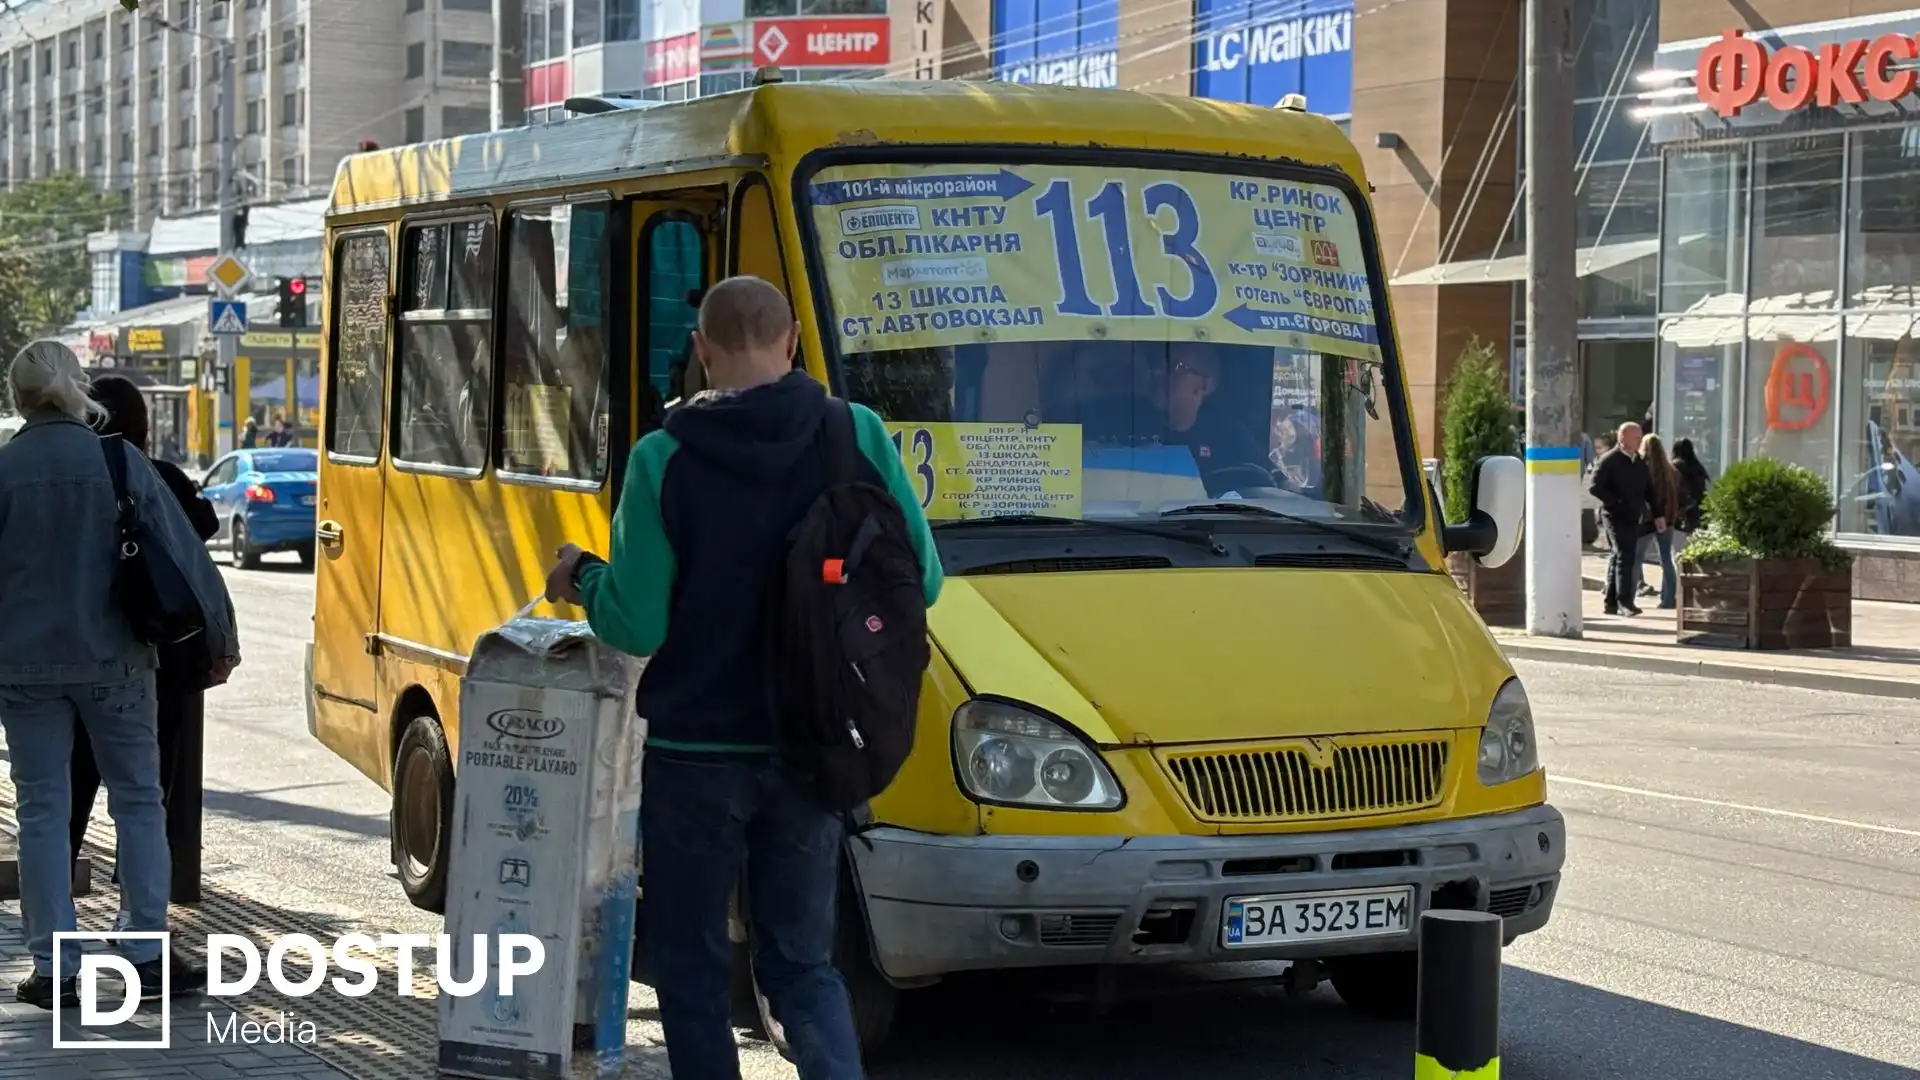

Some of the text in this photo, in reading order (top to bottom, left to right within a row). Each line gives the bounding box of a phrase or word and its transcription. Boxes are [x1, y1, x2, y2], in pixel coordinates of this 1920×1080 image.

[807, 32, 879, 55] ЦЕНТР
[1207, 32, 1241, 71] LC
[842, 178, 997, 199] 101-й мікрорайон
[1229, 181, 1342, 214] КР.РИНОК
[861, 206, 1007, 228] ЕПІЦЕНТР КНТУ
[1253, 208, 1326, 233] ЦЕНТР
[838, 232, 1022, 259] ОБЛ.ЛІКАРНЯ
[1033, 178, 1220, 320] 113
[887, 264, 960, 280] Маркетопт
[1228, 263, 1268, 280] к-тр
[872, 285, 1007, 311] 13 ШКОЛА
[1235, 286, 1291, 305] готель
[842, 306, 1044, 337] СТ.АВТОВОКЗАЛ
[1260, 315, 1363, 339] вул.ЄГОРОВА
[999, 443, 1052, 451] ЛІКАРНЯ
[1026, 435, 1057, 443] КНТУ
[966, 460, 1050, 468] ДЕНДРОПАРК
[974, 485, 1041, 493] ДРУКАРНЯ
[1034, 494, 1074, 502] ЦЕНТР
[466, 751, 577, 776] PORTABLE PLAYARD
[504, 784, 539, 807] 20%
[1245, 896, 1407, 936] BA 3523 EM
[1228, 928, 1241, 937] UA
